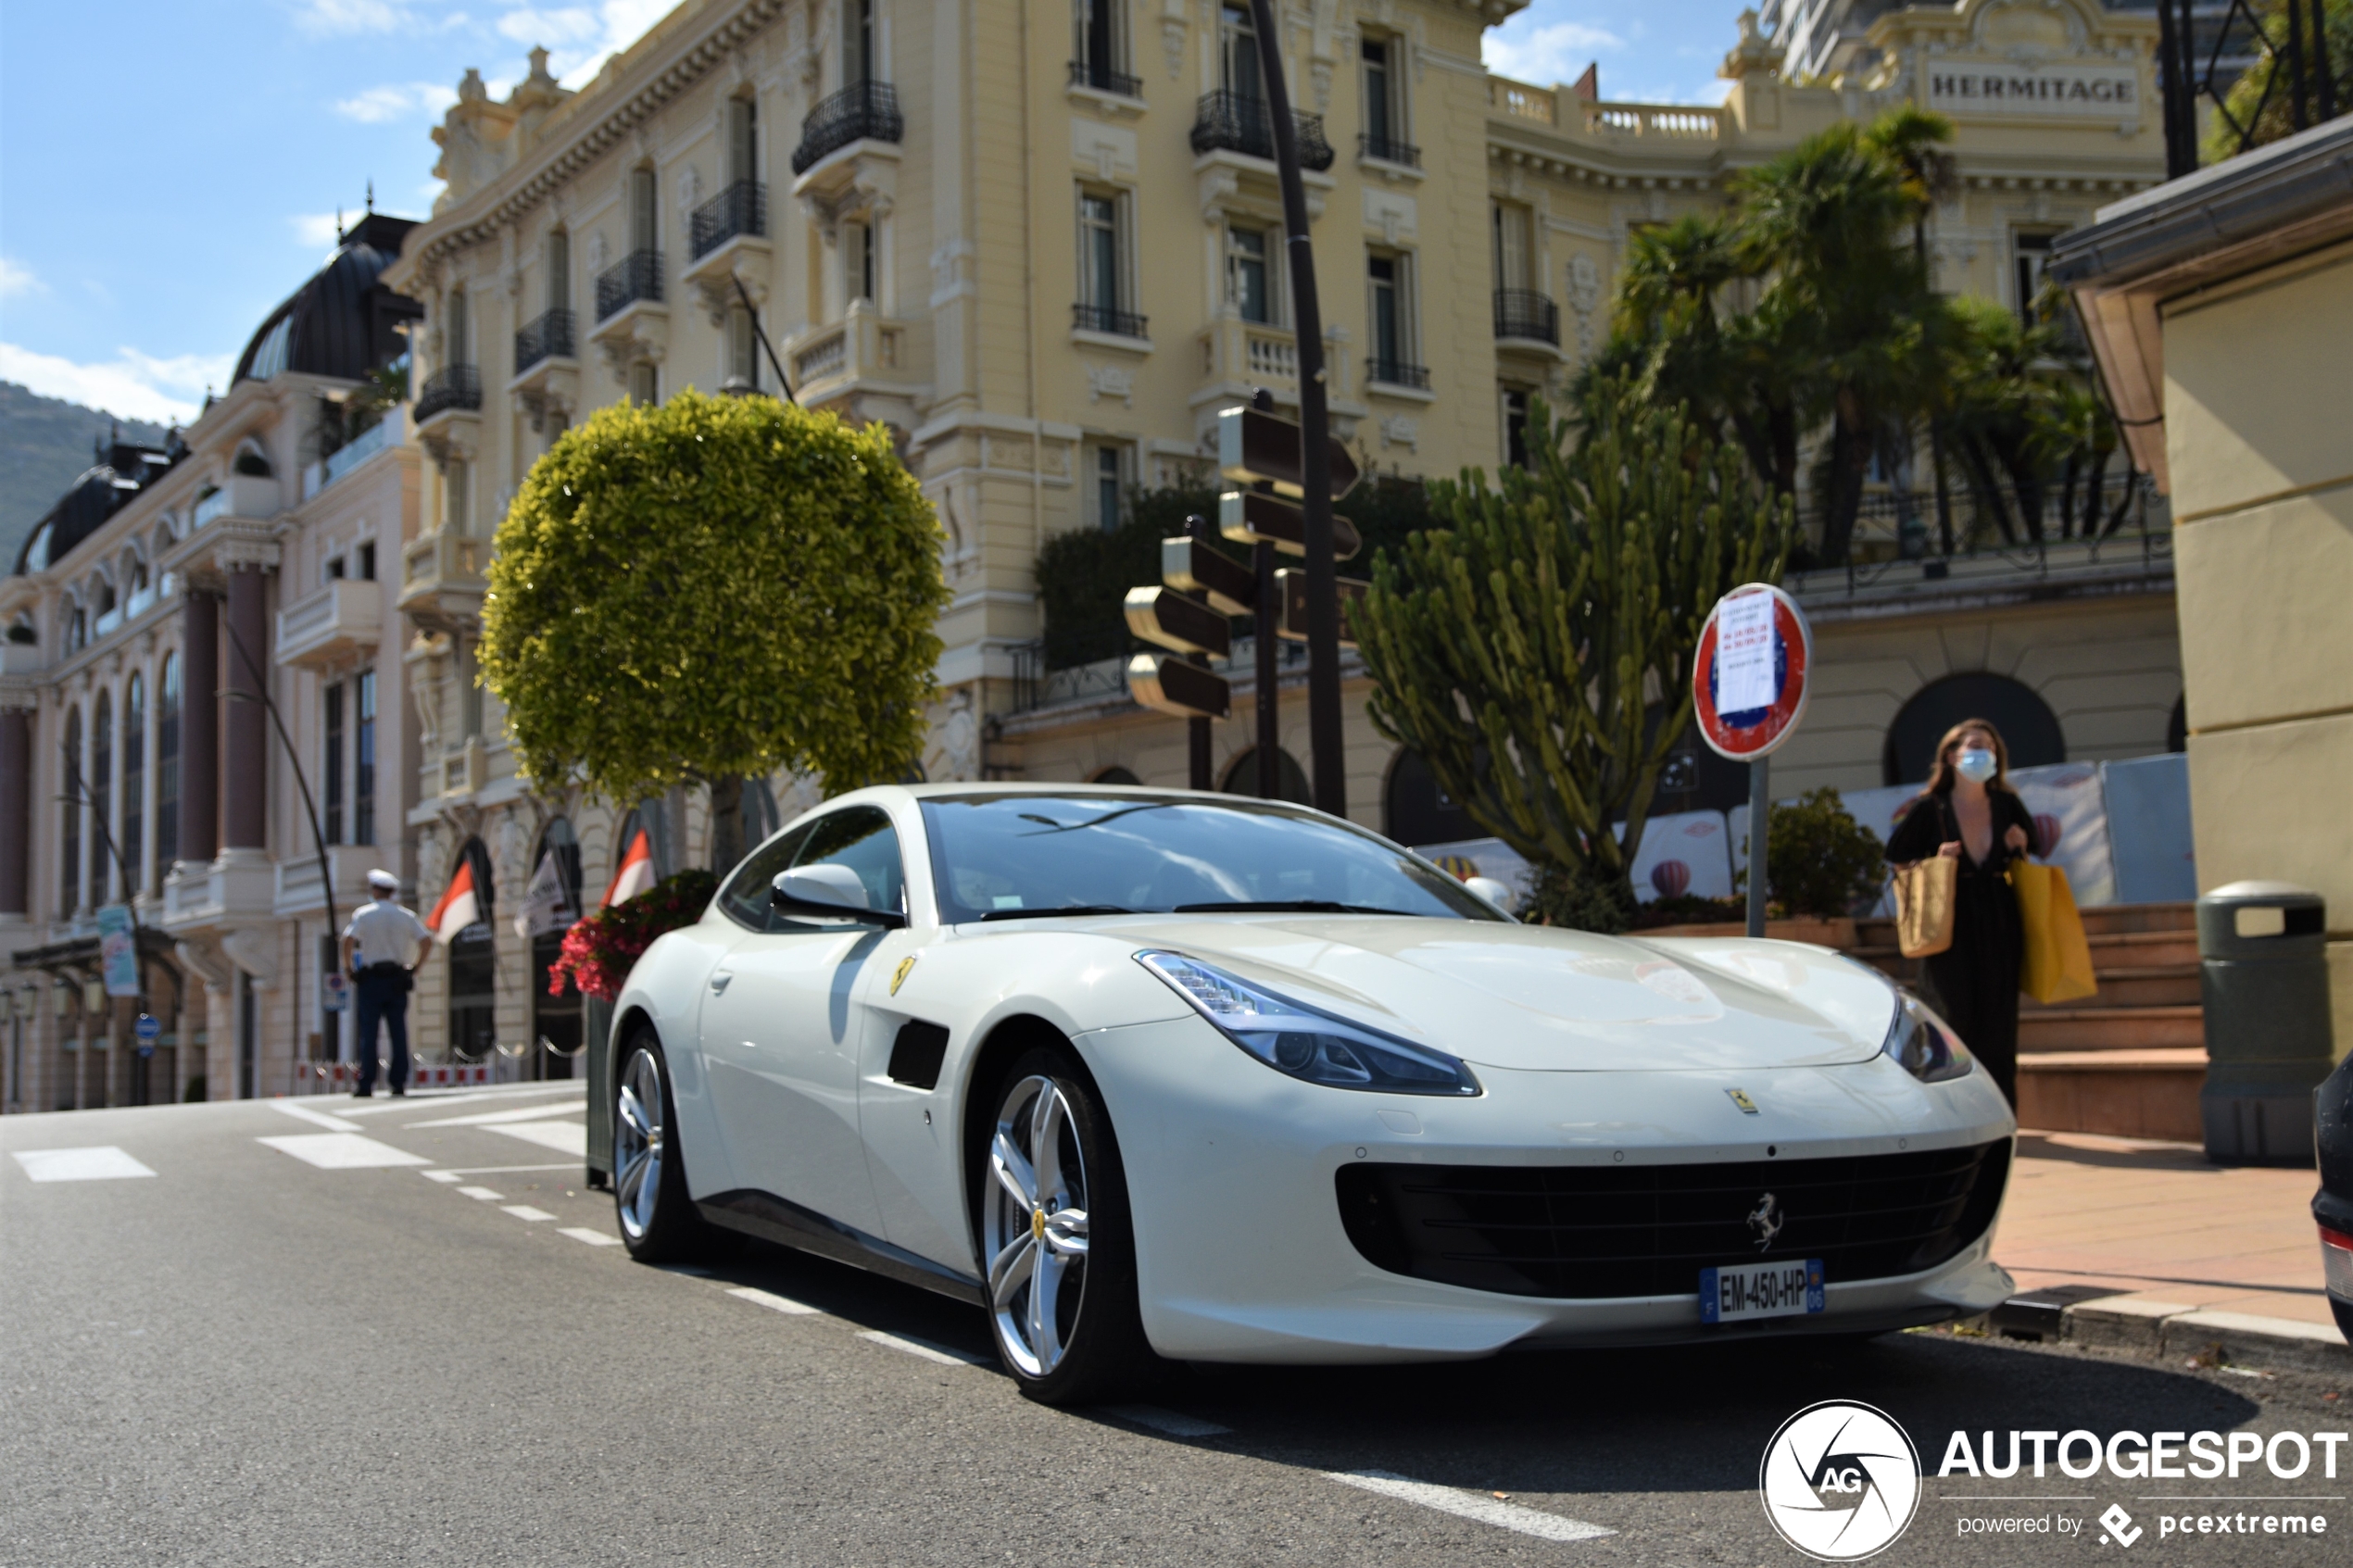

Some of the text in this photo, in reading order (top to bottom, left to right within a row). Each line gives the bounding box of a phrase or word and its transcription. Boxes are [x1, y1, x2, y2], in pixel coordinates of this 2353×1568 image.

[1932, 73, 2134, 104] HERMITAGE
[1720, 1268, 1806, 1312] EM-450-HP
[1807, 1289, 1823, 1310] 06
[1705, 1301, 1715, 1315] F
